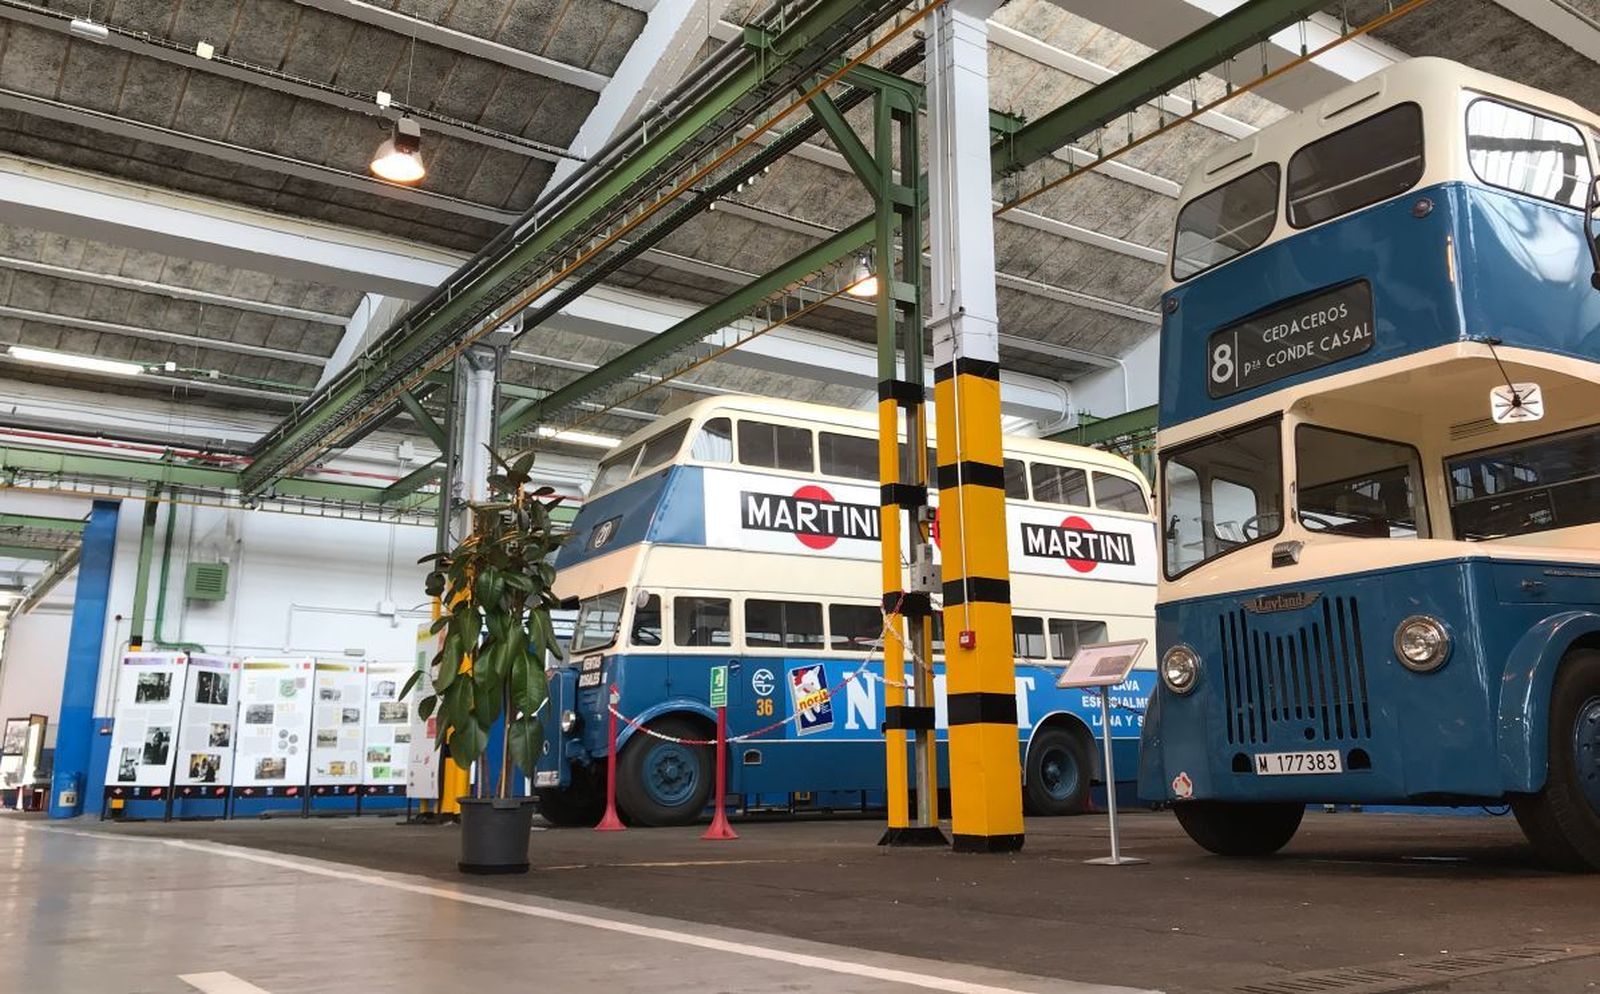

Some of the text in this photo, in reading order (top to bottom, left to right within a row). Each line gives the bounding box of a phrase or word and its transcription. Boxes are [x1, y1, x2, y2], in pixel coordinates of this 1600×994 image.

[1262, 303, 1348, 343] CEDACEROS
[1266, 341, 1315, 368] CONDE
[1319, 322, 1372, 351] CASAL
[1211, 343, 1234, 384] 8
[747, 495, 879, 538] MARTINI
[1026, 526, 1130, 562] MARTINI
[1112, 680, 1140, 691] LAVA
[756, 698, 773, 716] 36
[1125, 715, 1133, 727] Y
[1259, 753, 1337, 773] M 177383
